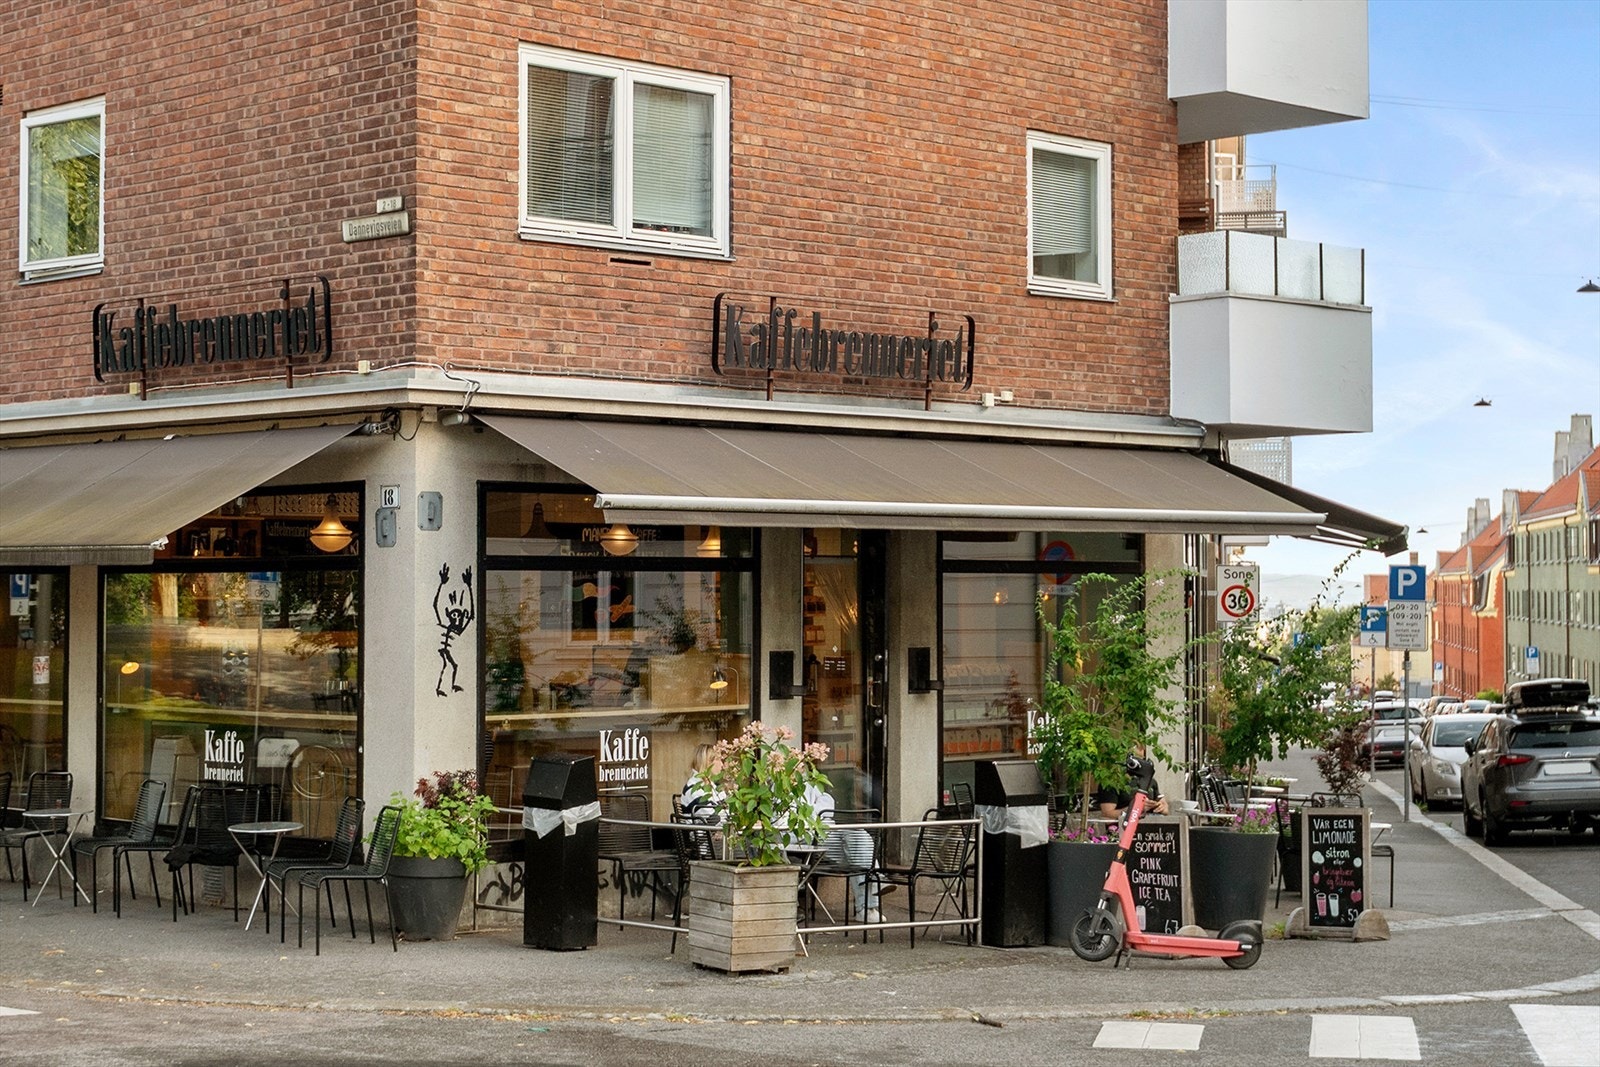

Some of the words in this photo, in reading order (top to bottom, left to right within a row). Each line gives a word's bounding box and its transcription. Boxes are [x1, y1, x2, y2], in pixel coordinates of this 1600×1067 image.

[100, 286, 323, 373] Kaffebrenneriet
[724, 303, 968, 383] Kaffebrenneriet
[383, 489, 394, 506] 18
[1223, 568, 1253, 580] Sone
[1397, 568, 1418, 597] P
[1228, 593, 1249, 609] 30
[1366, 608, 1380, 629] P
[1528, 647, 1536, 658] P
[204, 729, 245, 764] Kaffe
[599, 727, 649, 762] Kaffe
[204, 763, 244, 782] brenneriet
[599, 763, 649, 782] brenneriet
[1333, 819, 1354, 829] EGEN
[1145, 827, 1163, 841] smak
[1165, 831, 1175, 841] av
[1312, 830, 1357, 844] LIMONADE
[1134, 840, 1176, 853] sommer!
[1325, 846, 1350, 859] sitron
[1140, 857, 1161, 870] PINK
[1131, 869, 1178, 887] GRAPEFRUIT
[1138, 886, 1151, 899] ICE
[1154, 887, 1171, 901] TEA
